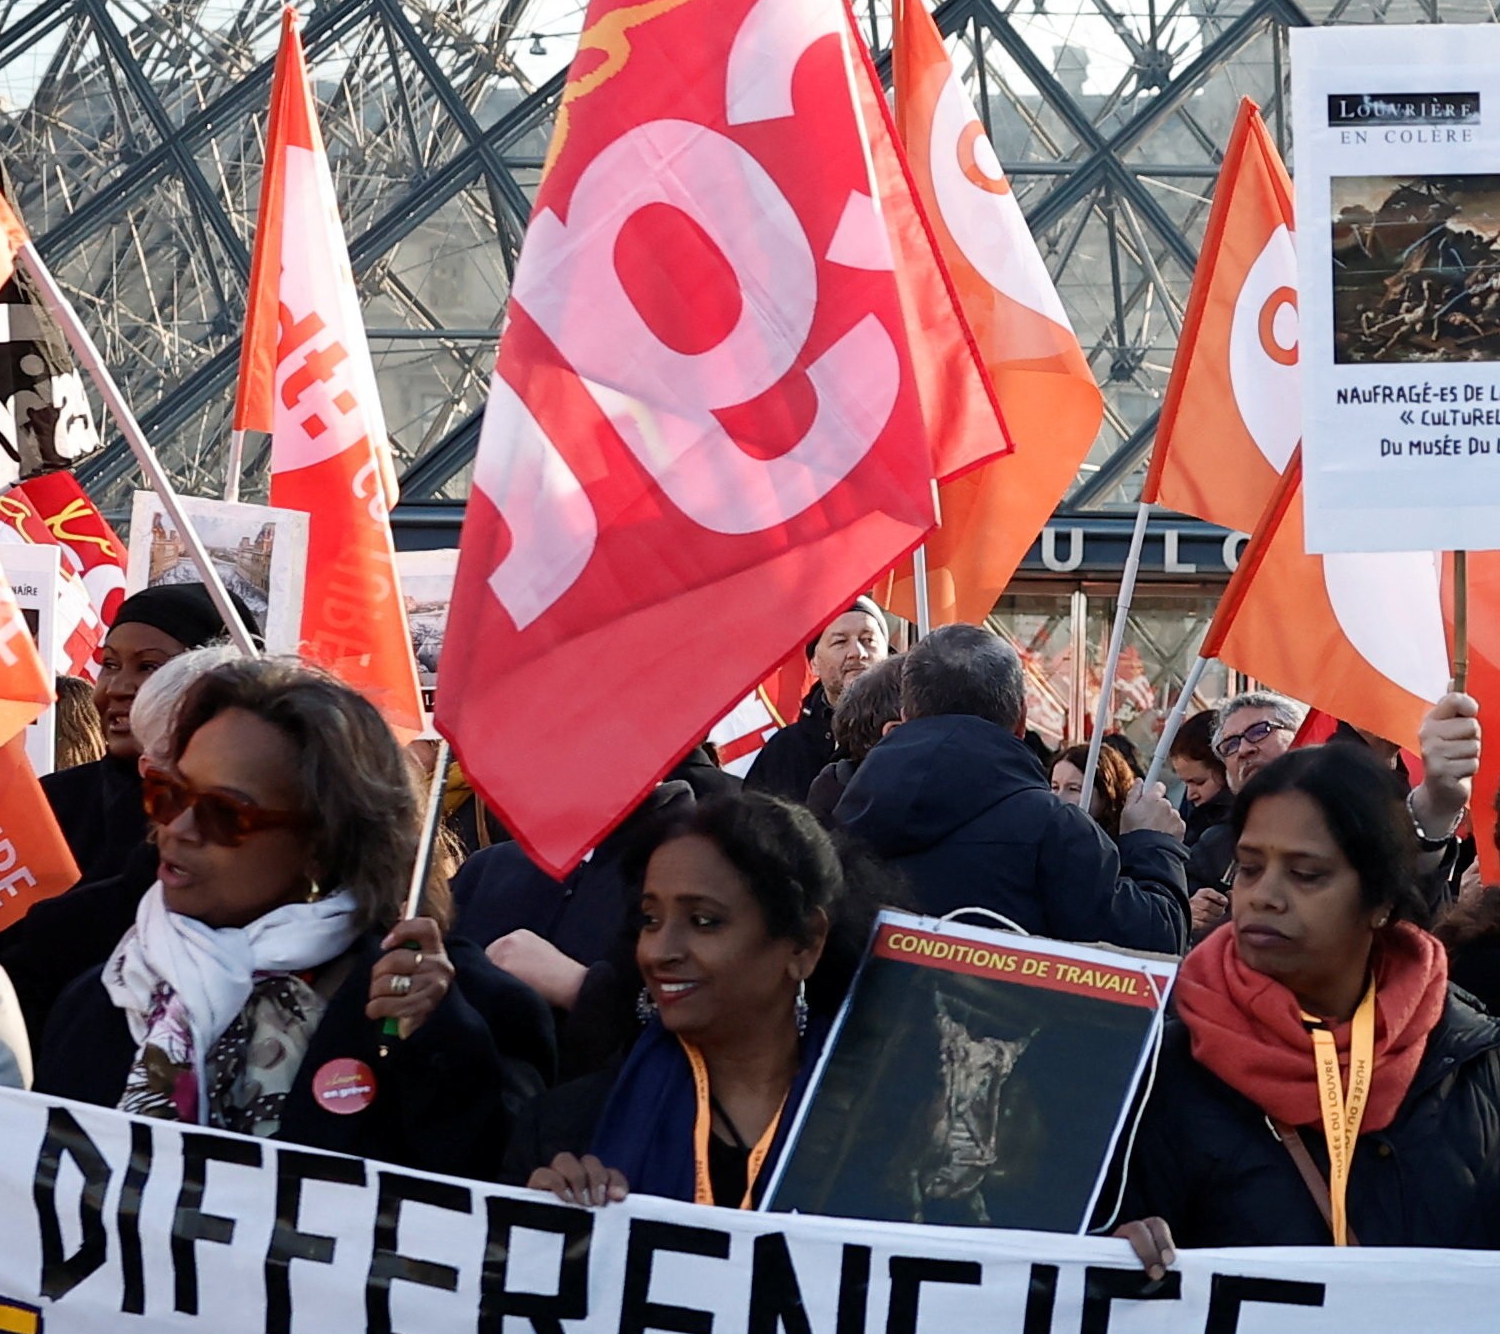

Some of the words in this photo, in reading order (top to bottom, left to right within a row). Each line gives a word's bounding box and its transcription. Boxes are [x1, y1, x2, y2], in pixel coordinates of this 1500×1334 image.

[1340, 130, 1368, 145] EN
[1385, 125, 1473, 145] COLÈRE
[1464, 385, 1484, 403] DE
[1381, 437, 1403, 457] DU
[1409, 435, 1462, 456] MUSÉE
[1468, 436, 1490, 455] DU
[887, 933, 1017, 972] CONDITIONS
[1021, 958, 1051, 978] DE
[1055, 964, 1138, 995] TRAVAIL
